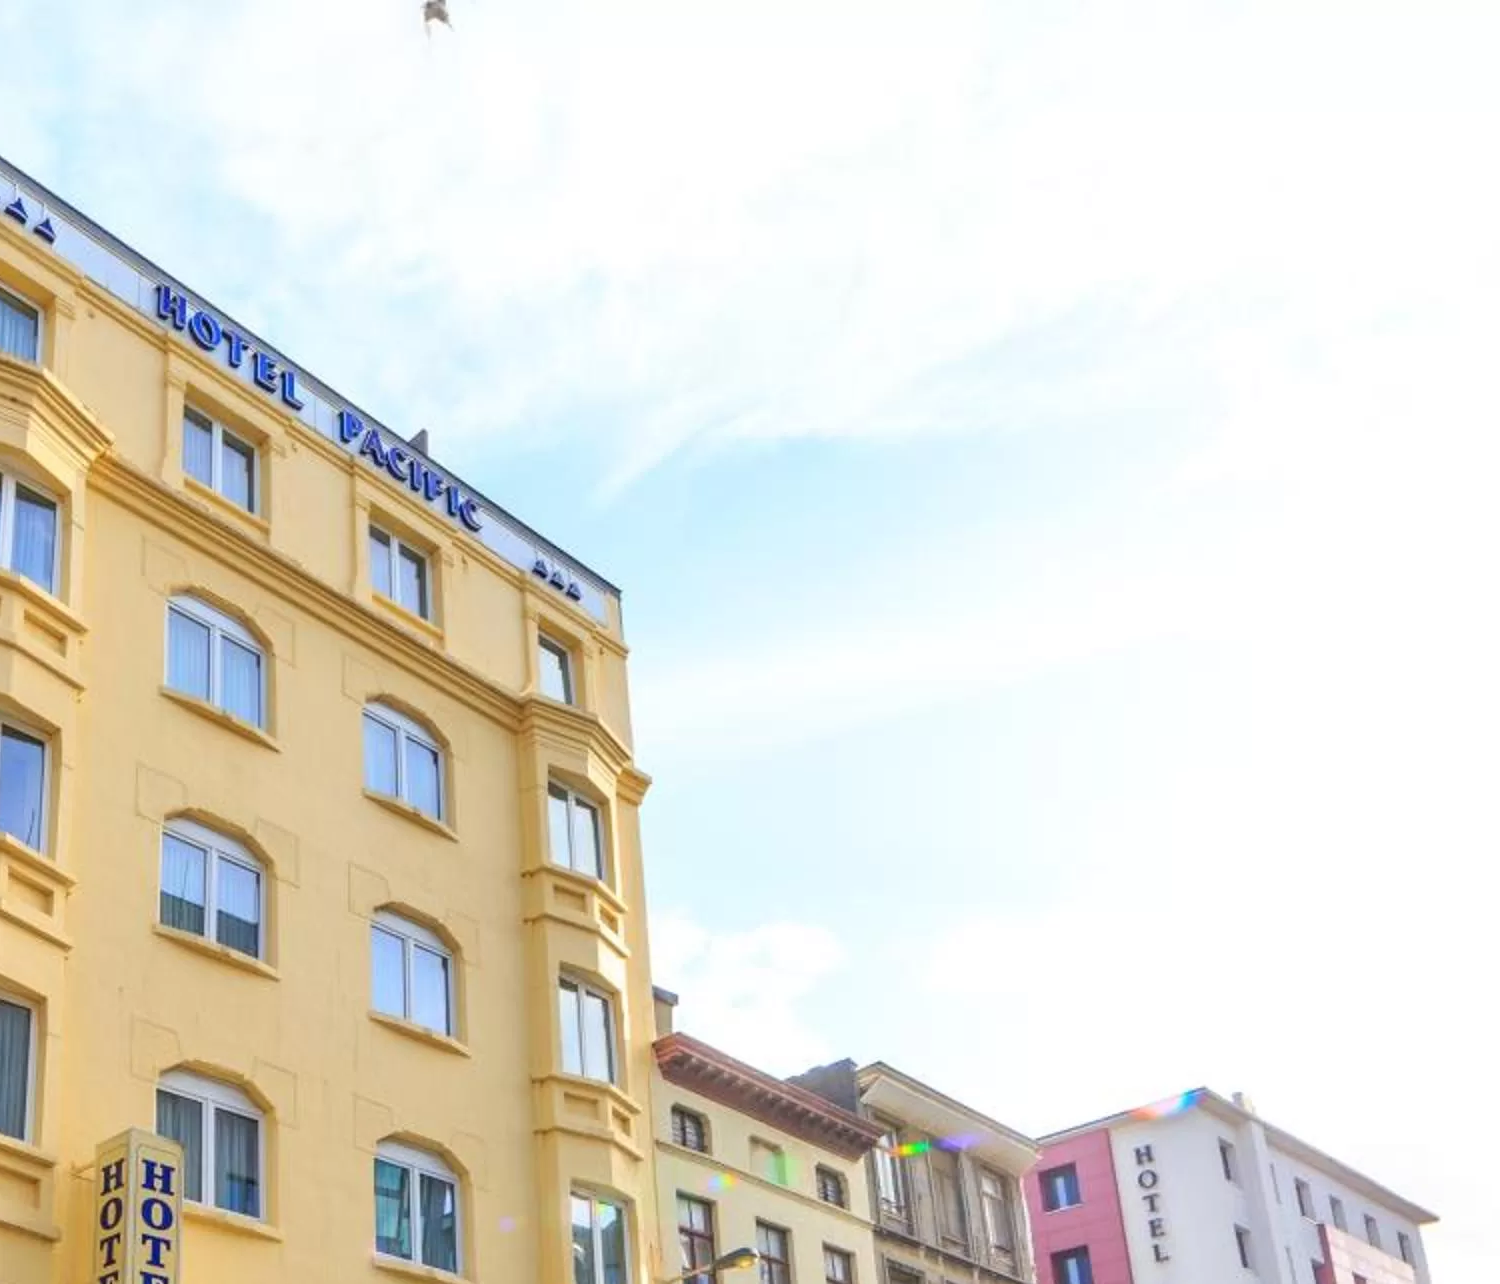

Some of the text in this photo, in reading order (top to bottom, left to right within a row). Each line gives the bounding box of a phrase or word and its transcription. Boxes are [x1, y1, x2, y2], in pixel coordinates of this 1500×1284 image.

[156, 284, 484, 533] HOTEL PACIFIC
[1133, 1143, 1171, 1264] HOTEL
